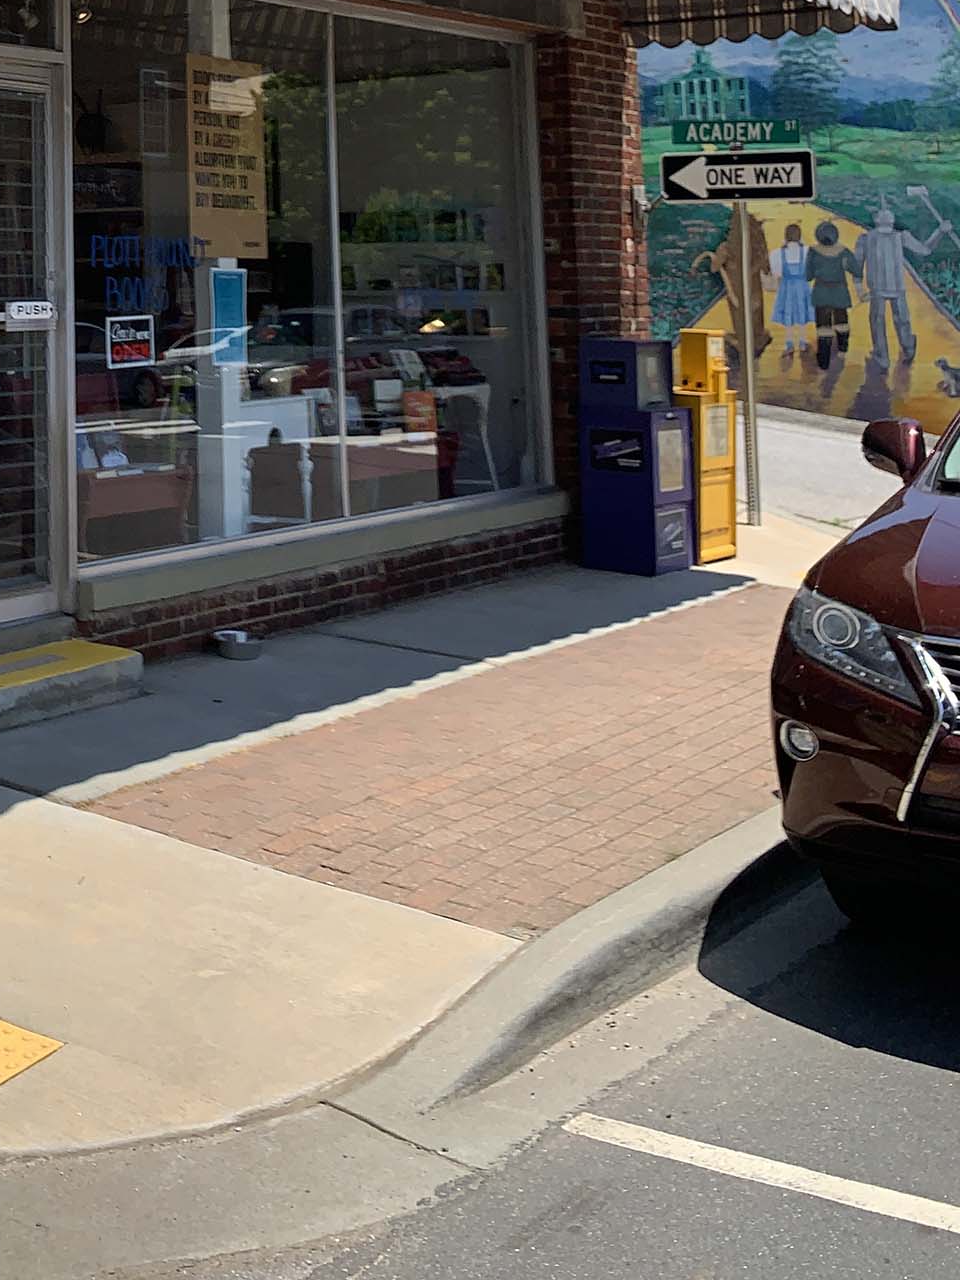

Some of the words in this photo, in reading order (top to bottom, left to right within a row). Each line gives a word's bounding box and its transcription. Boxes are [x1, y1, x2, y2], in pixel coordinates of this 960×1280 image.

[686, 122, 774, 142] ACADEMY
[784, 120, 797, 131] ST
[706, 168, 746, 186] ONE
[753, 166, 795, 184] WAY
[90, 234, 141, 269] PLOTT
[17, 304, 49, 315] PUSH
